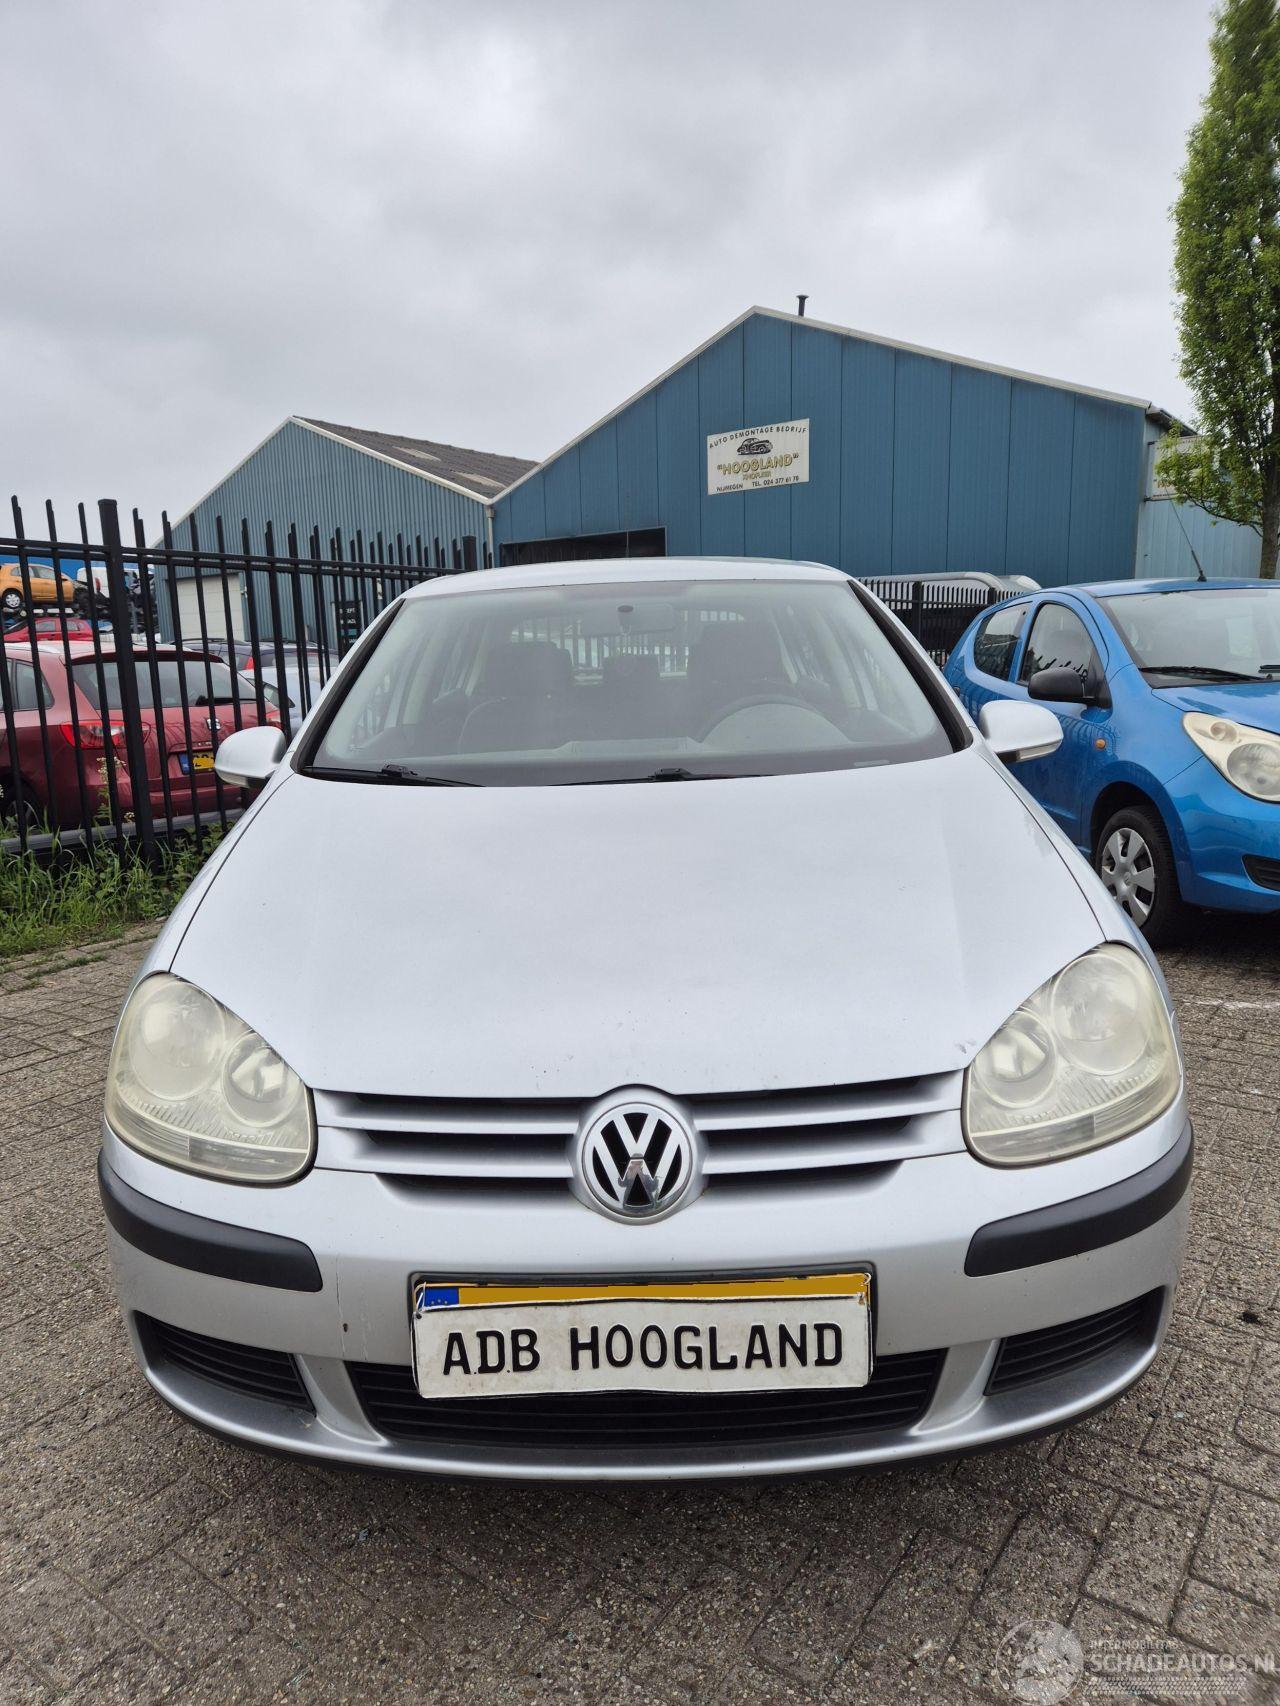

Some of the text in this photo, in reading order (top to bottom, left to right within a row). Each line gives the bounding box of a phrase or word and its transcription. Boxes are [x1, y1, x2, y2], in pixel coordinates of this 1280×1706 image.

[709, 426, 806, 449] AUTO DEMONTAGE BEDRIJF
[717, 483, 743, 492] NIJMEGEN
[763, 478, 773, 486] 024
[569, 1322, 843, 1371] HOOGLAND
